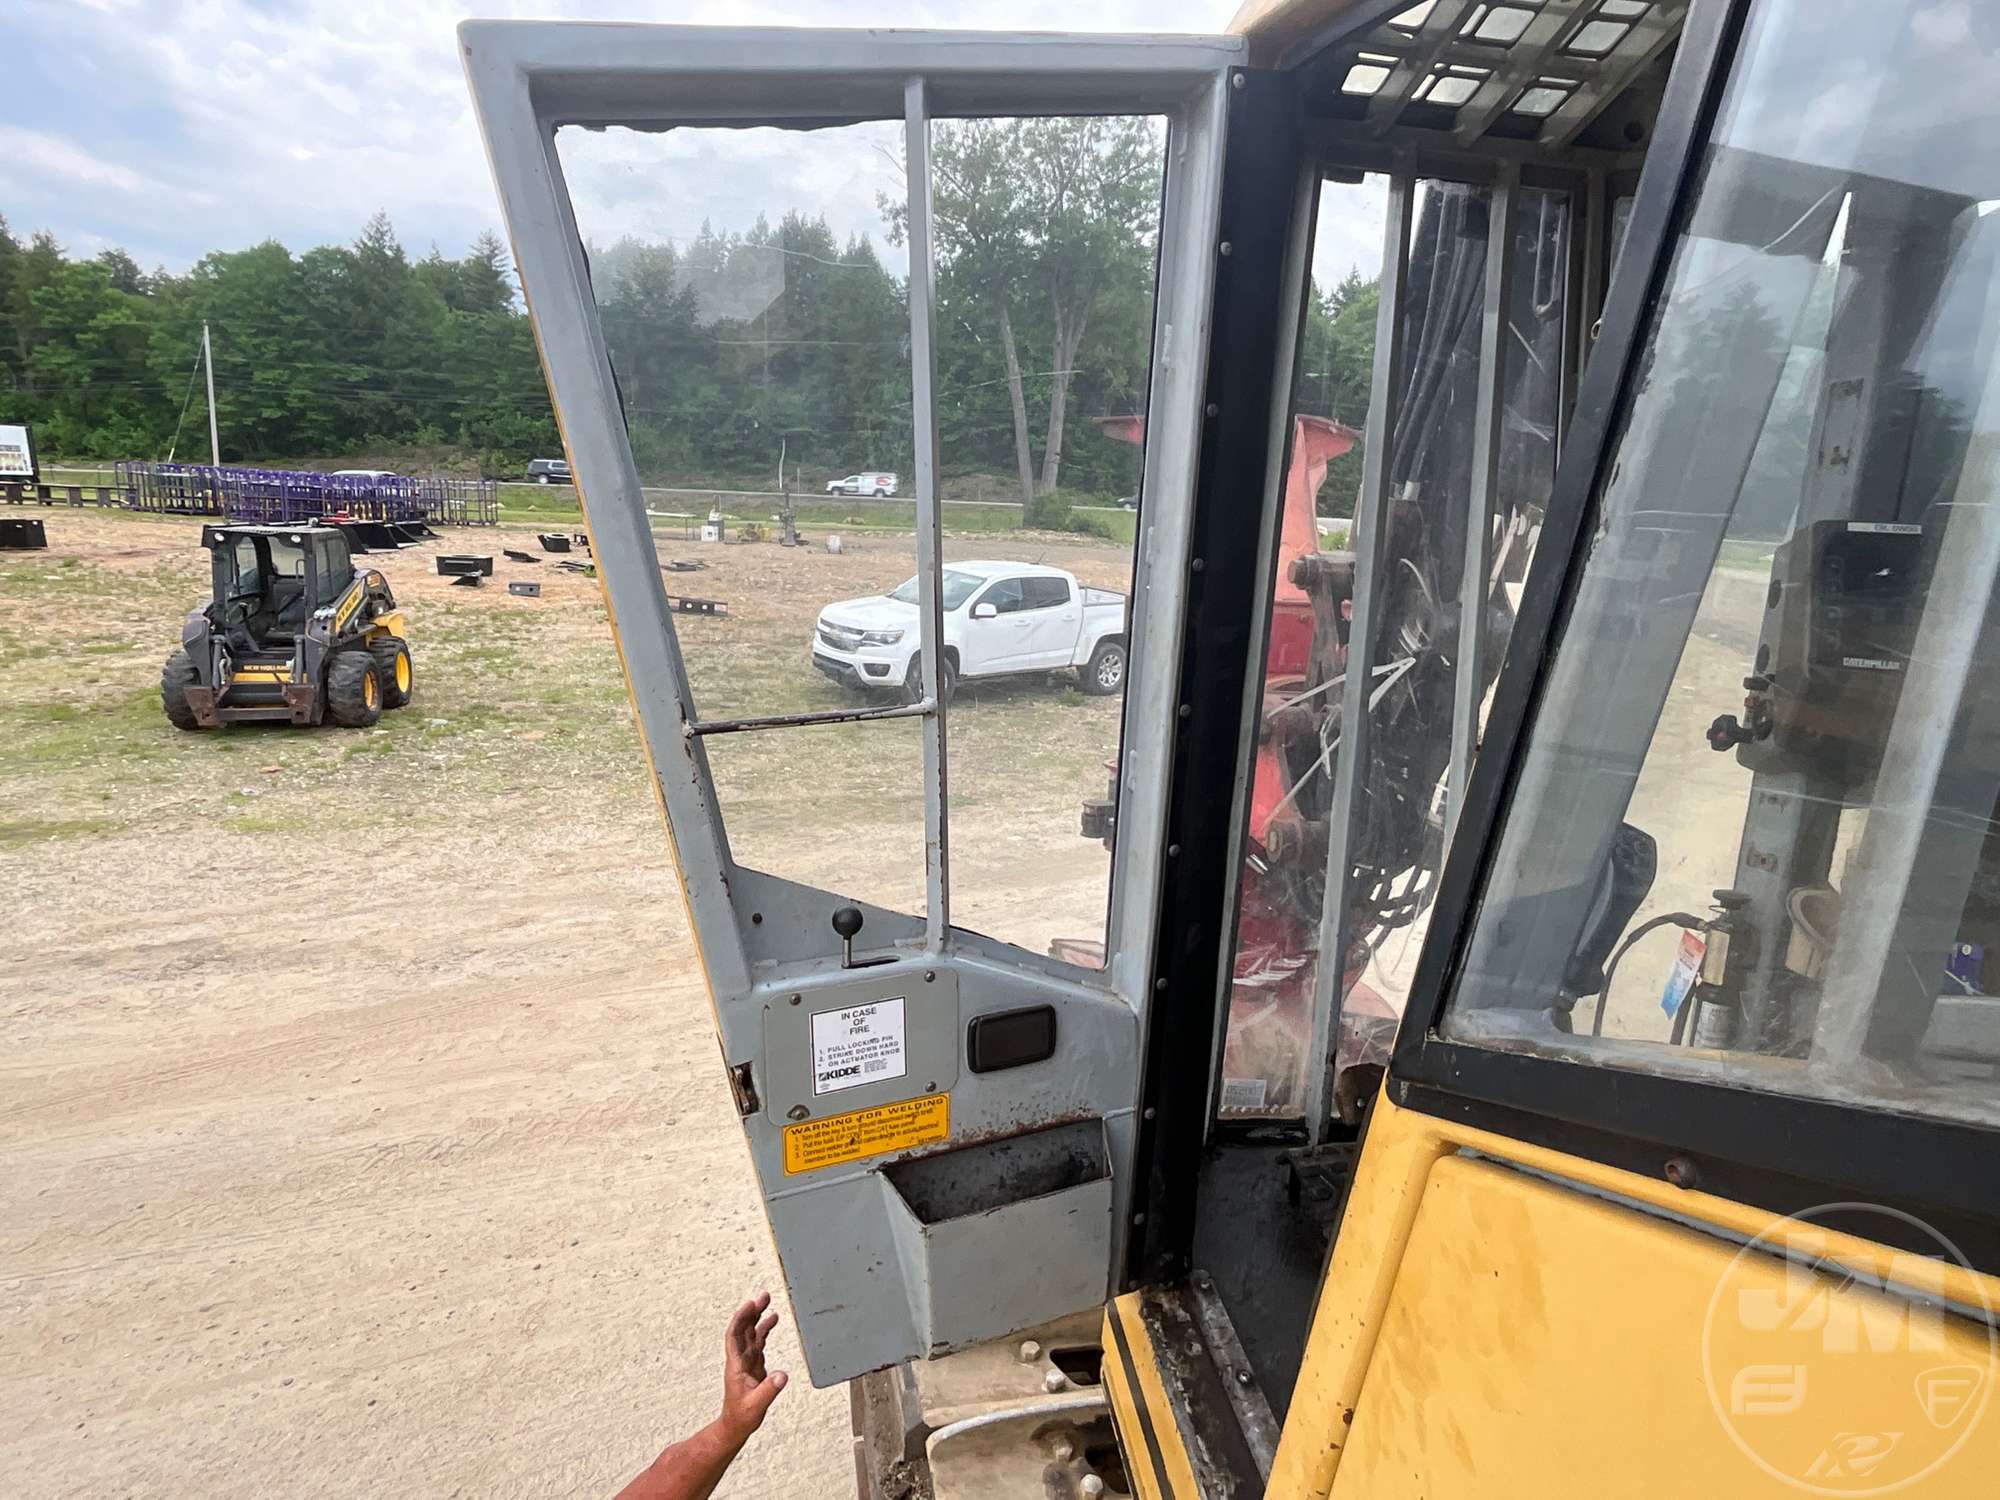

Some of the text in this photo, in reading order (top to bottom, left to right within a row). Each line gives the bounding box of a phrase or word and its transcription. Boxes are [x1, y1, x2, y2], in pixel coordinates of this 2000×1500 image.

[1843, 657, 1900, 669] CATERPILLAR
[841, 1007, 877, 1020] IN CASE
[853, 1017, 866, 1026] OF
[850, 1025, 870, 1035] FIRE
[828, 1044, 846, 1053] PULL
[848, 1037, 880, 1049] LOCKING
[828, 1050, 853, 1060] STRIKE
[856, 1046, 877, 1054] DOWN
[879, 1040, 899, 1049] HARD
[841, 1052, 878, 1064] ACTUATOR
[880, 1048, 900, 1057] KNOB
[826, 1065, 861, 1080] KIDDE
[791, 1117, 852, 1135] WARNING
[856, 1111, 882, 1123] FOR
[888, 1098, 943, 1114] WELDING
